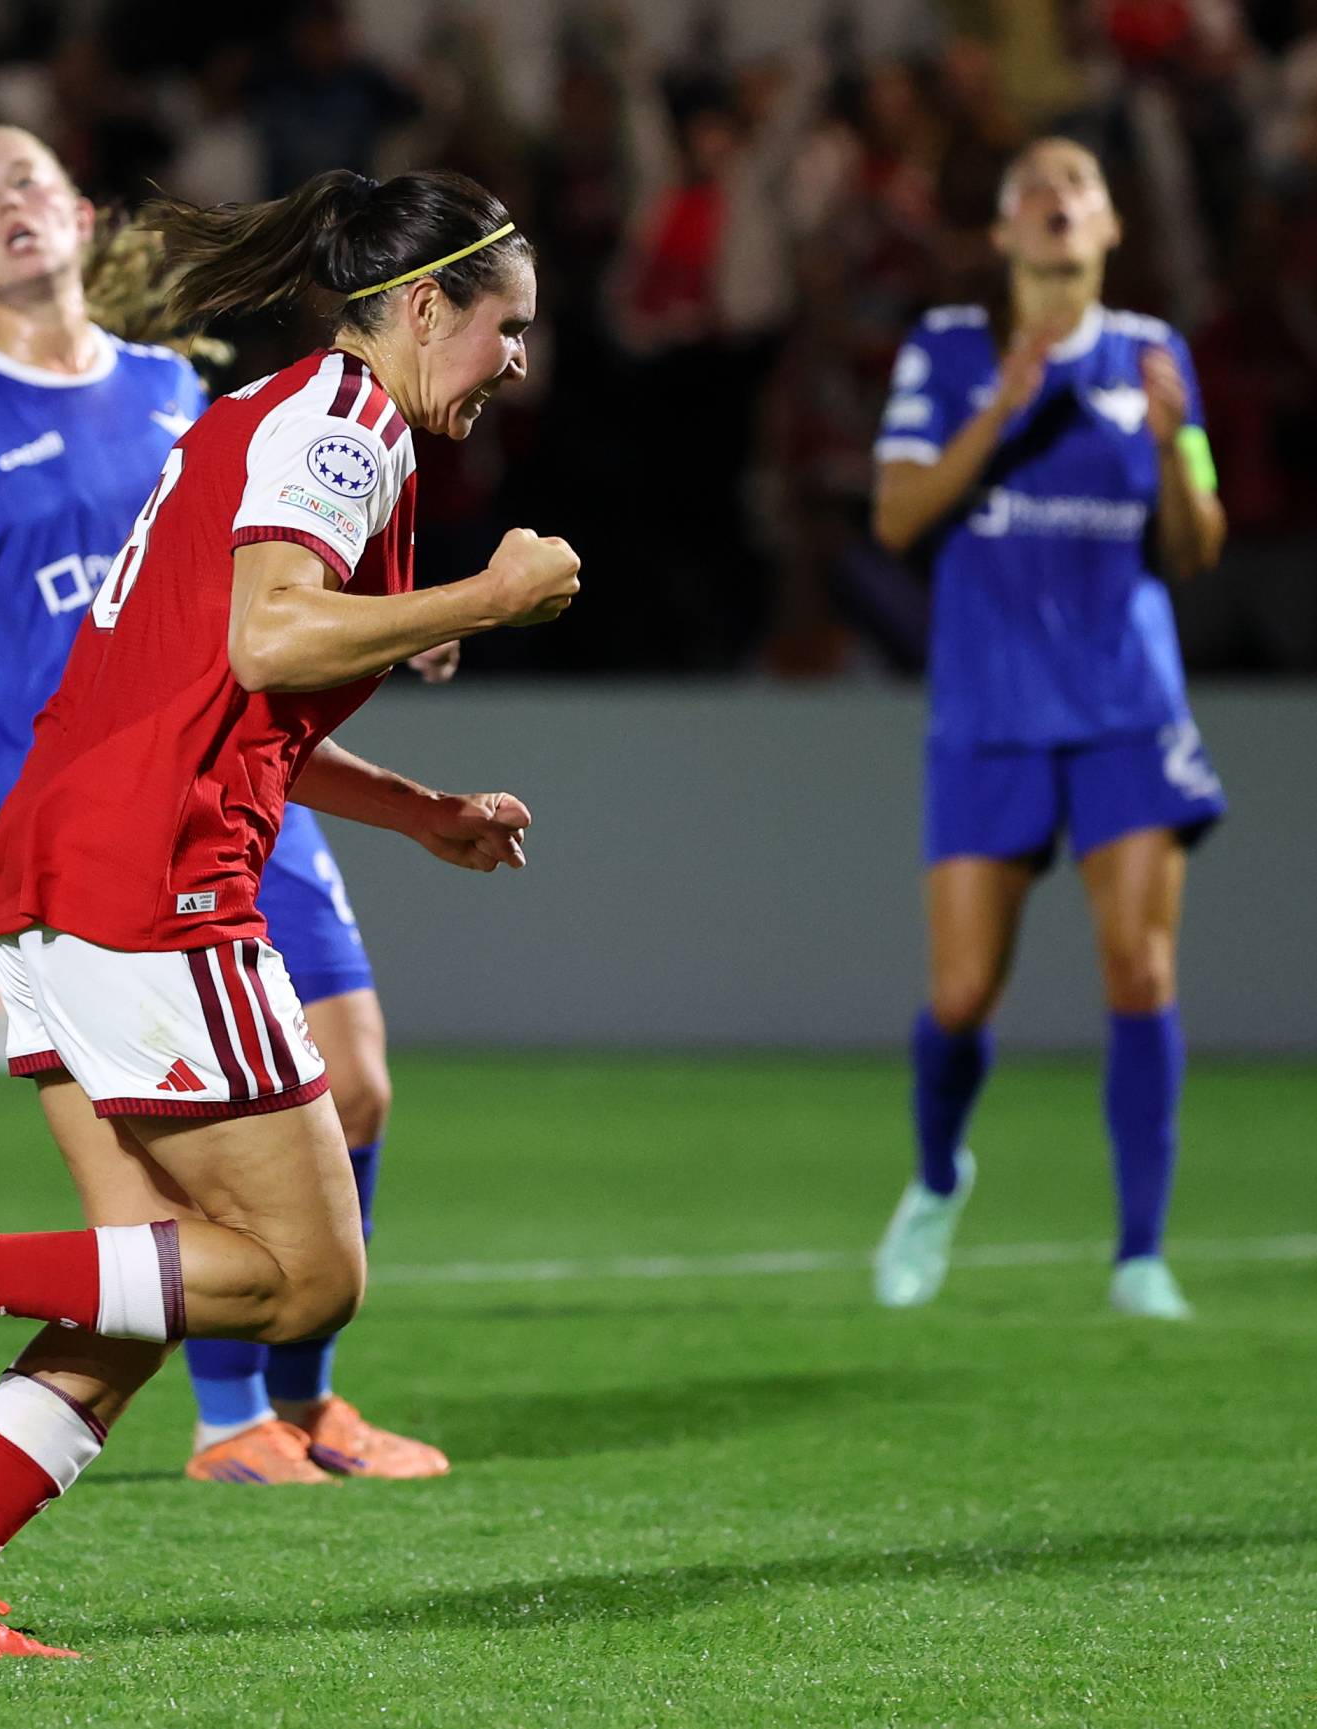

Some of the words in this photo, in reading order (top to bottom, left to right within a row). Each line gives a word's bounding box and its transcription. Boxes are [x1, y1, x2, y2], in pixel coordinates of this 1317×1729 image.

[284, 484, 305, 492] UEFA
[91, 447, 184, 629] 8
[278, 490, 362, 540] FOUNDATION
